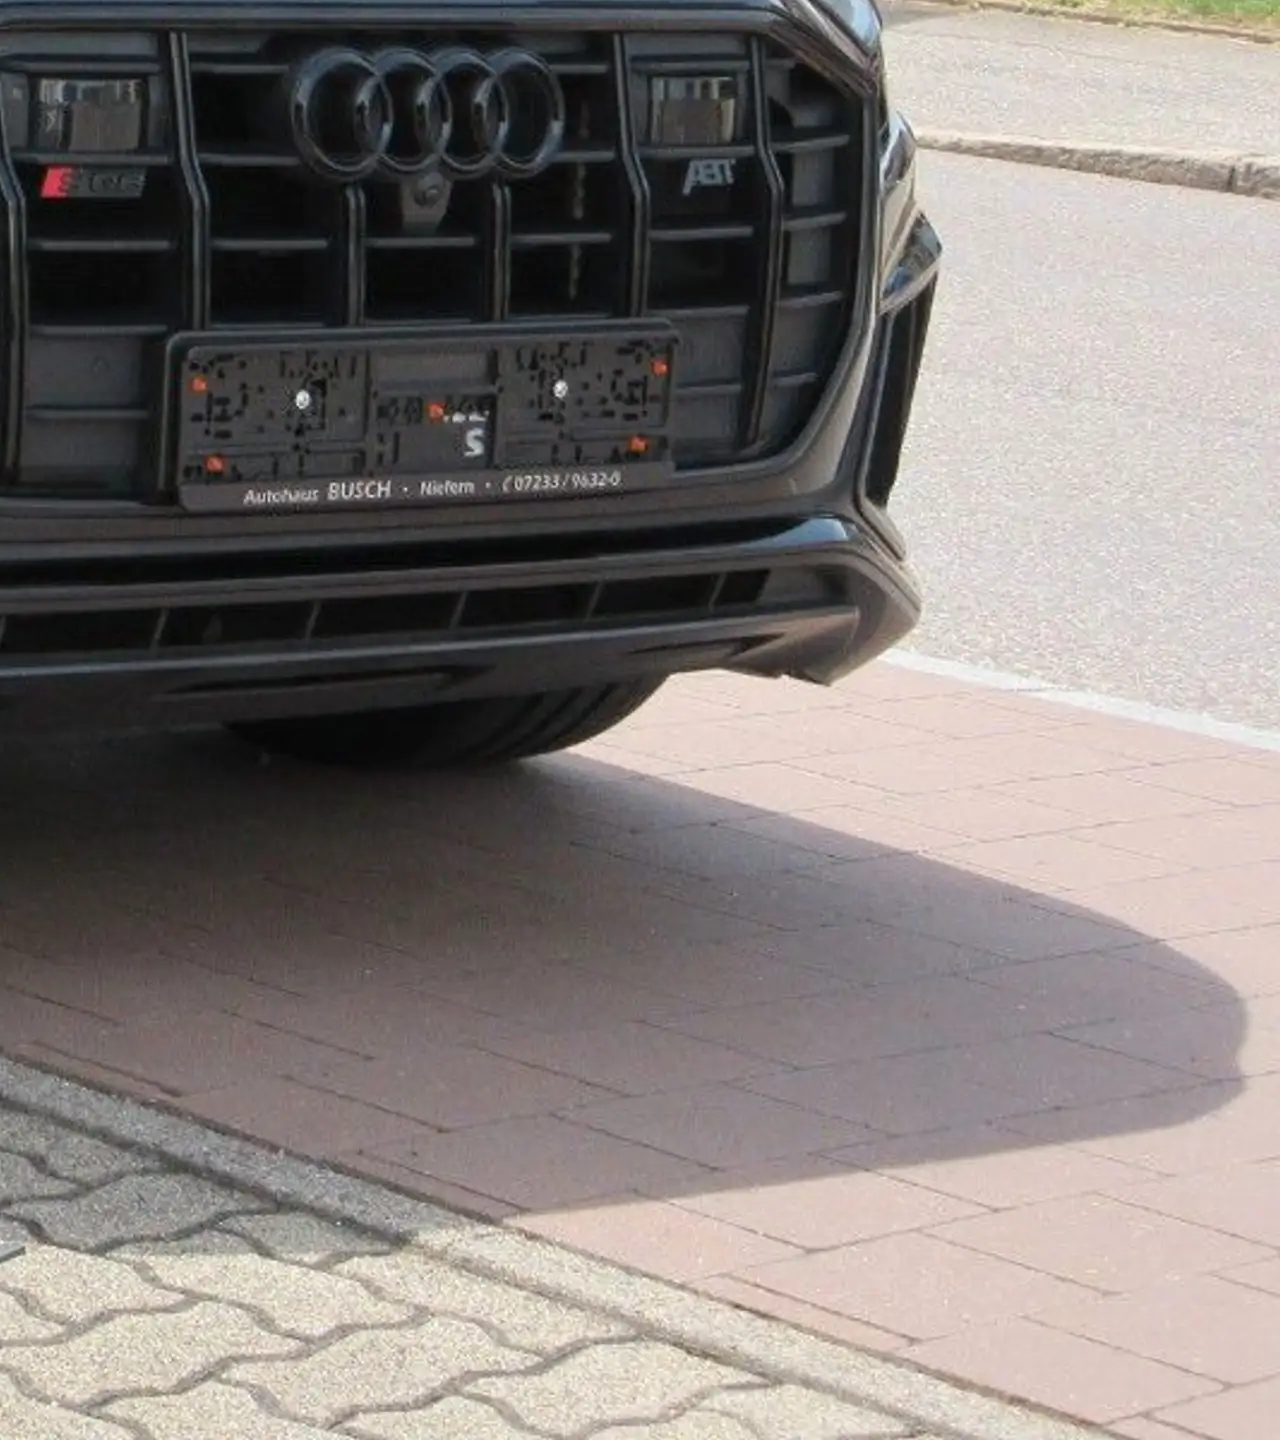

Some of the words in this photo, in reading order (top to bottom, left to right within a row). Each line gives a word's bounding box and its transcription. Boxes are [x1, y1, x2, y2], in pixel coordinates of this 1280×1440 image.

[682, 158, 736, 196] ABT
[243, 488, 320, 506] Autohaus
[326, 480, 392, 501] BUSCH
[420, 480, 476, 496] Niefern
